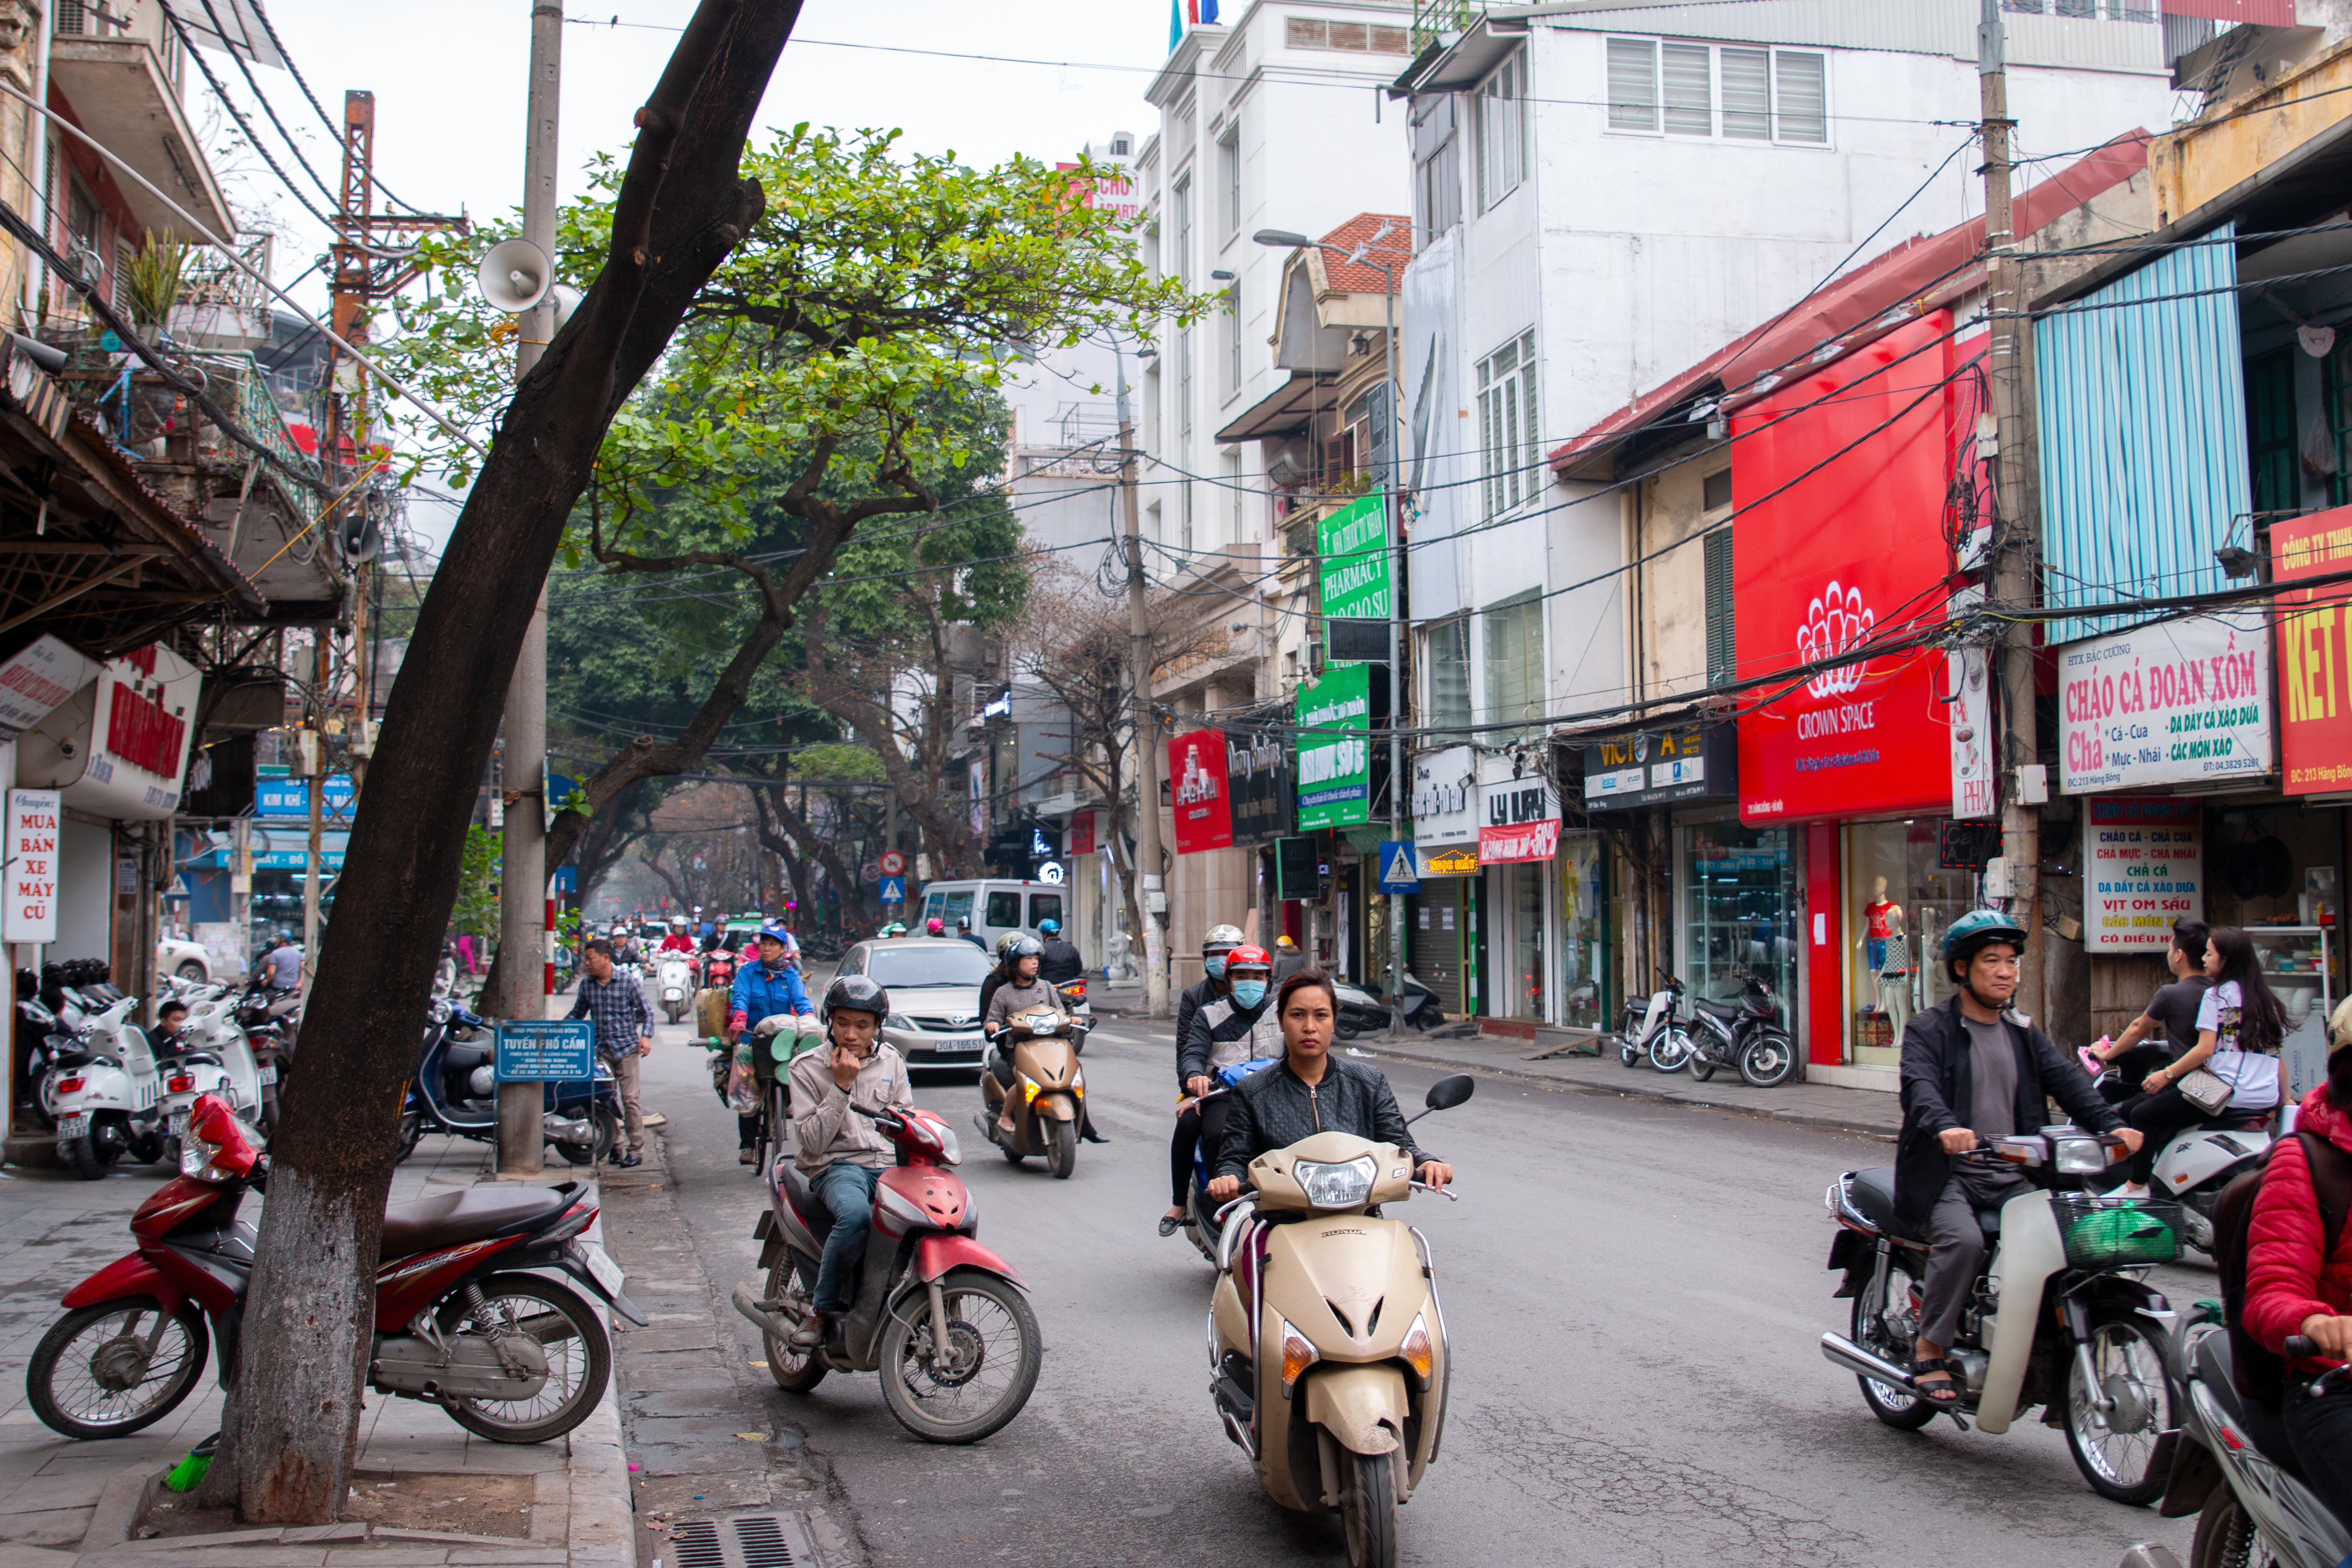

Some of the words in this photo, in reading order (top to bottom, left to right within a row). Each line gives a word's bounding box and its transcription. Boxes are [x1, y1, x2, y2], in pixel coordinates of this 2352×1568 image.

[2282, 534, 2311, 570] CÔNG
[2312, 533, 2324, 564] TY
[1325, 551, 1382, 602] PHARMACY
[1372, 589, 1388, 617] SU
[2068, 655, 2084, 666] HTX
[2086, 646, 2101, 663] BẮC
[2103, 643, 2131, 659] CƯỜNG
[2066, 665, 2114, 723] CHÁO
[2119, 656, 2145, 714] CÁ
[2150, 658, 2204, 710] ĐOAN
[1798, 707, 1838, 740] CROWN
[1841, 701, 1874, 733] SPACE
[2204, 706, 2215, 729] CÁ
[2112, 726, 2122, 741] Cá
[2130, 724, 2148, 739] Cua
[2068, 722, 2103, 773] Chả
[2189, 735, 2210, 759] MÓN
[1795, 757, 1805, 772] UK
[1806, 756, 1822, 773] Style
[1823, 754, 1832, 767] for
[1833, 752, 1856, 767] Babies
[1863, 748, 1879, 762] Kids
[2112, 752, 2131, 770] Mực
[2139, 747, 2160, 764] Nhái
[2216, 760, 2242, 770] 04.3829
[2079, 778, 2089, 786] 213
[2090, 775, 2105, 785] Hàng
[2106, 773, 2120, 782] Bông
[2305, 768, 2317, 781] 213
[2318, 766, 2336, 783] Hàng
[15, 794, 55, 809] Chuyên:
[263, 793, 282, 806] KIM
[21, 815, 57, 829] MUA
[21, 833, 55, 852] BÁN
[2100, 830, 2125, 842] CHÁO
[2129, 830, 2141, 842] CÁ
[2151, 828, 2171, 842] CHẢ
[2174, 832, 2193, 842] CUA
[2097, 845, 2116, 859] CHẢ
[2119, 848, 2141, 861] MỰC
[2151, 845, 2171, 859] CHẢ
[25, 860, 47, 874] XE
[1430, 860, 1453, 873] NGỌC
[2127, 863, 2149, 876] CHẢ
[2153, 864, 2168, 876] CÁ
[18, 878, 55, 897] MÁY
[2098, 882, 2111, 894] DẠ
[2137, 880, 2150, 892] CÁ
[24, 900, 46, 919] CŨ
[2103, 900, 2127, 912] VỊT
[2132, 900, 2155, 910] OM
[2162, 896, 2190, 911] SẤU
[2102, 914, 2128, 927] CÁC
[2132, 914, 2163, 927] MÓN
[2101, 933, 2119, 943] CÓ
[503, 1035, 536, 1050] TUYẾN
[539, 1035, 560, 1050] PHỐ
[562, 1035, 585, 1050] CẤM
[938, 1040, 981, 1050] 30A-165.51
[1321, 1229, 1368, 1237] HONDA
